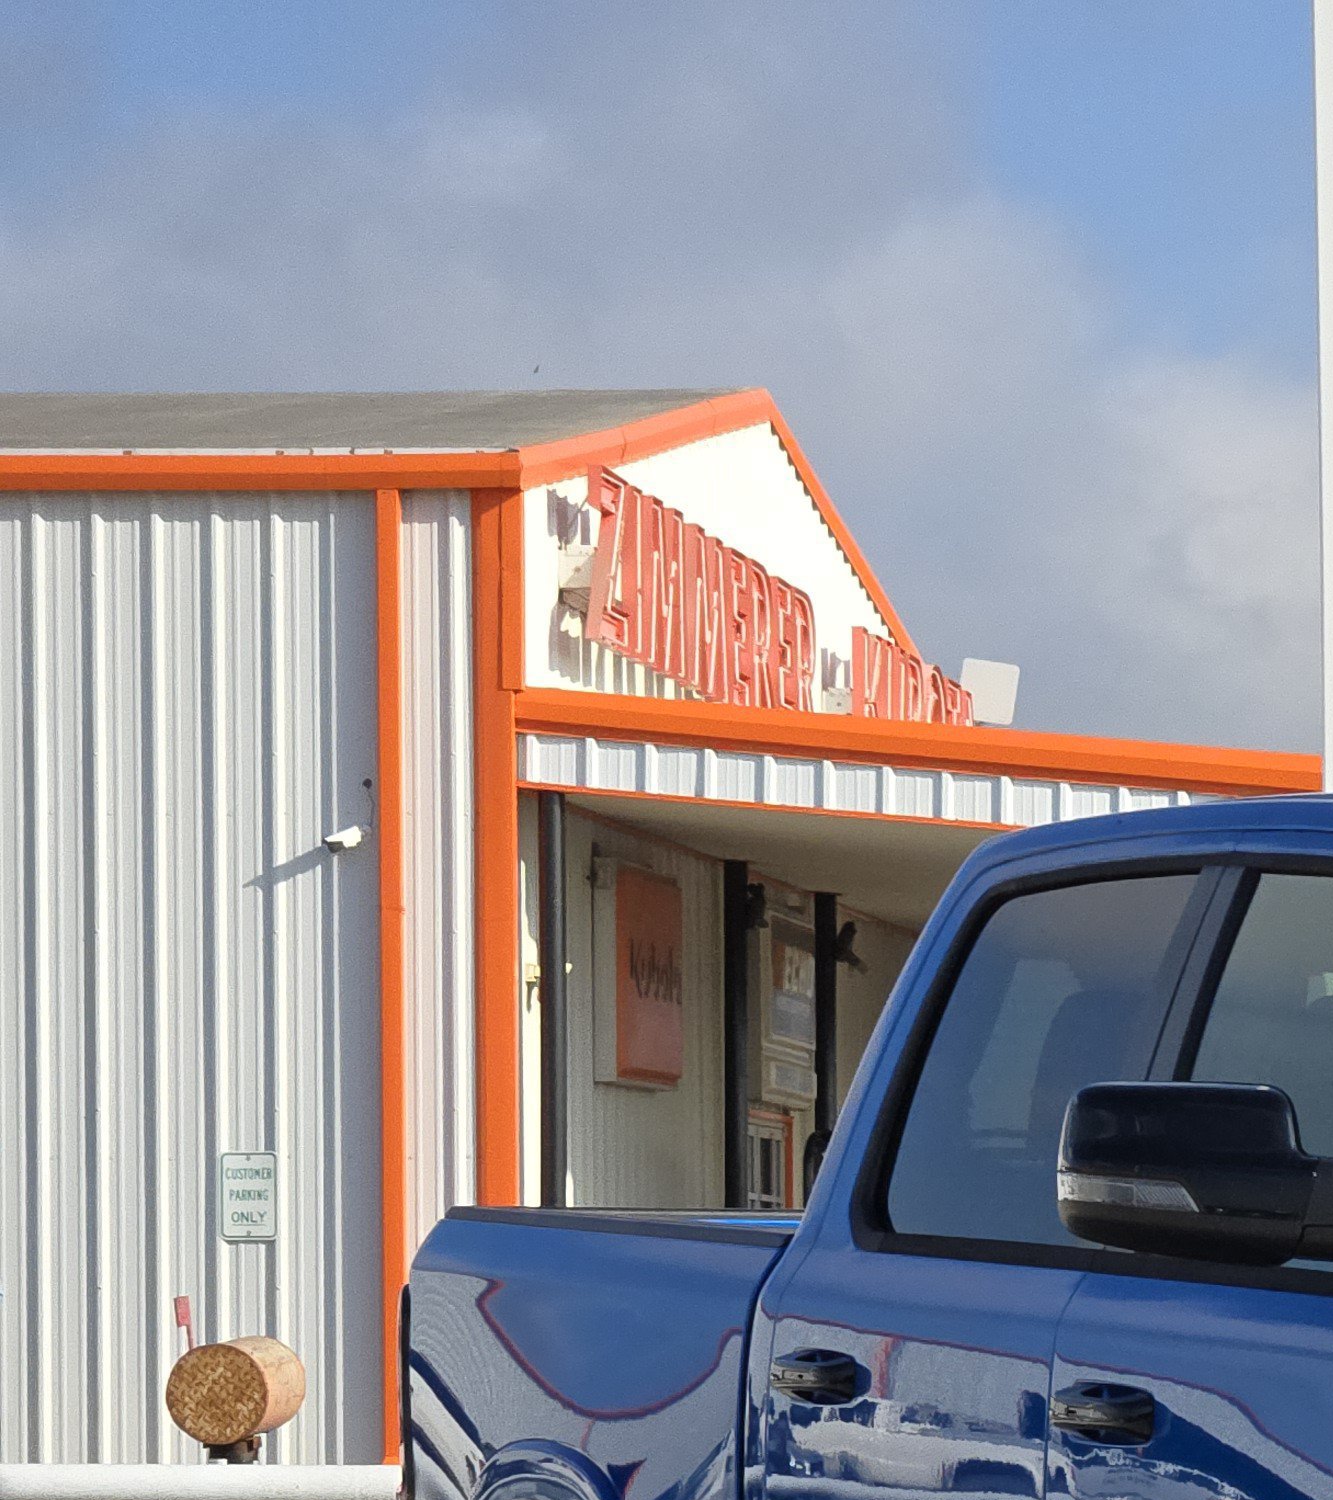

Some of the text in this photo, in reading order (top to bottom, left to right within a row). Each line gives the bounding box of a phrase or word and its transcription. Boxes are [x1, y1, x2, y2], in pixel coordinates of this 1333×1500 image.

[225, 1167, 272, 1180] CUSTOMER
[229, 1189, 269, 1201] PARKING
[231, 1211, 267, 1223] ONLY
